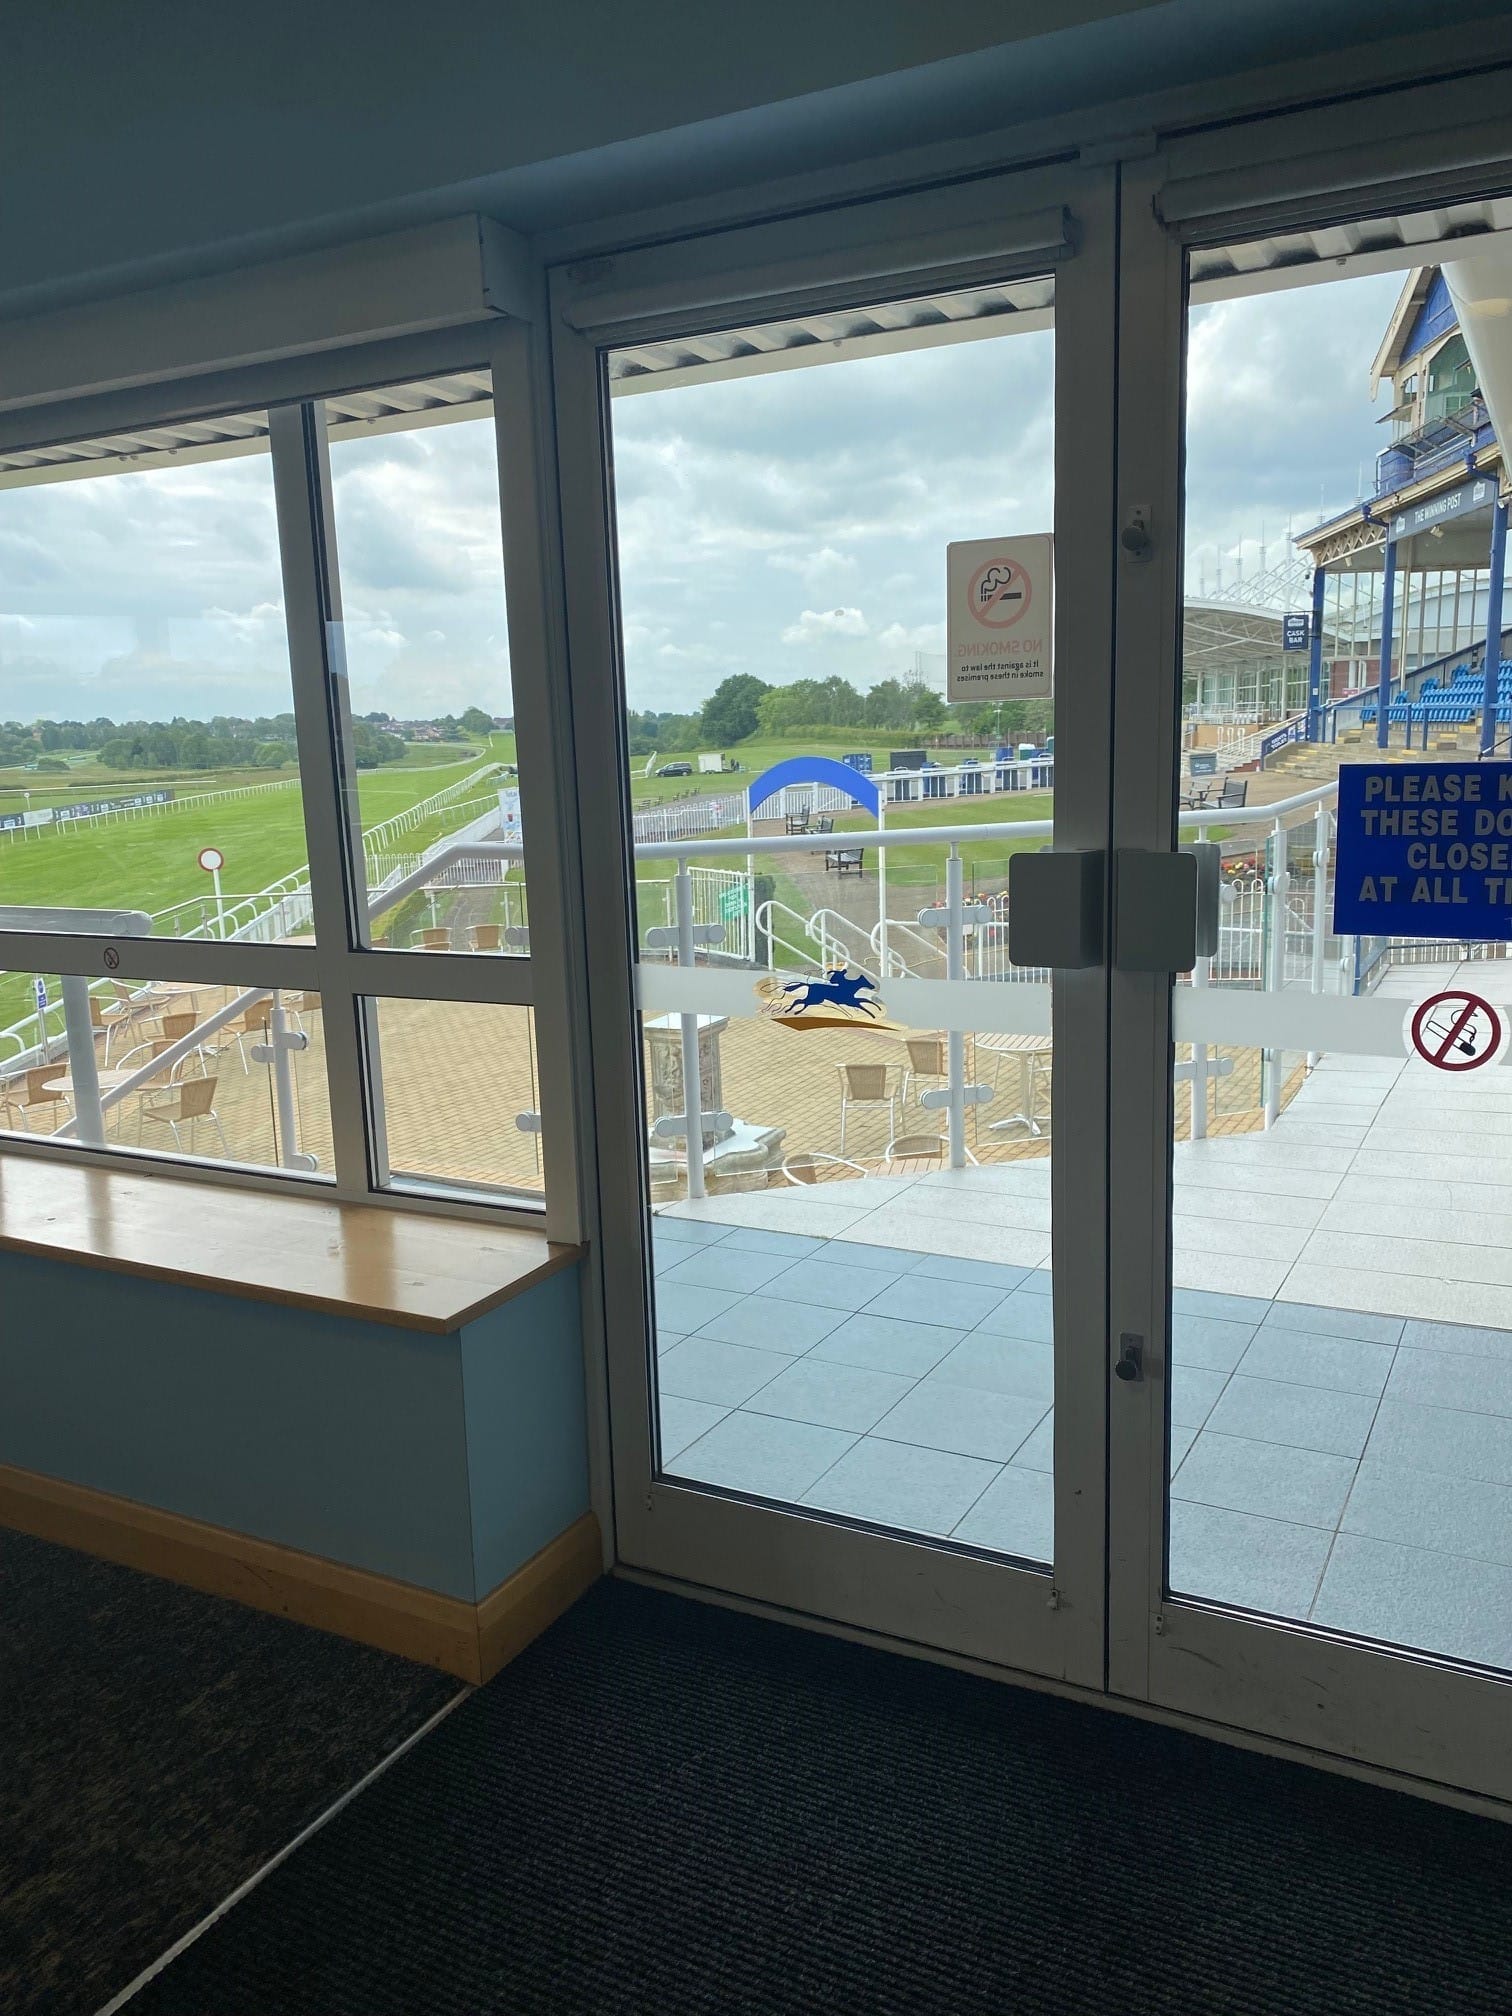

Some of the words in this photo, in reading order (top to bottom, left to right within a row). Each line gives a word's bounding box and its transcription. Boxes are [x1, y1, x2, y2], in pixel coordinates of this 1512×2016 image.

[1415, 509, 1424, 524] THE
[1425, 499, 1446, 520] WINNING
[1447, 493, 1461, 510] POST
[1288, 636, 1303, 644] BAR
[1365, 774, 1481, 802] PLEASE
[1361, 809, 1458, 836] THESE
[1407, 842, 1512, 870] CLOSE
[1359, 876, 1398, 902] AT
[1411, 877, 1468, 903] ALL
